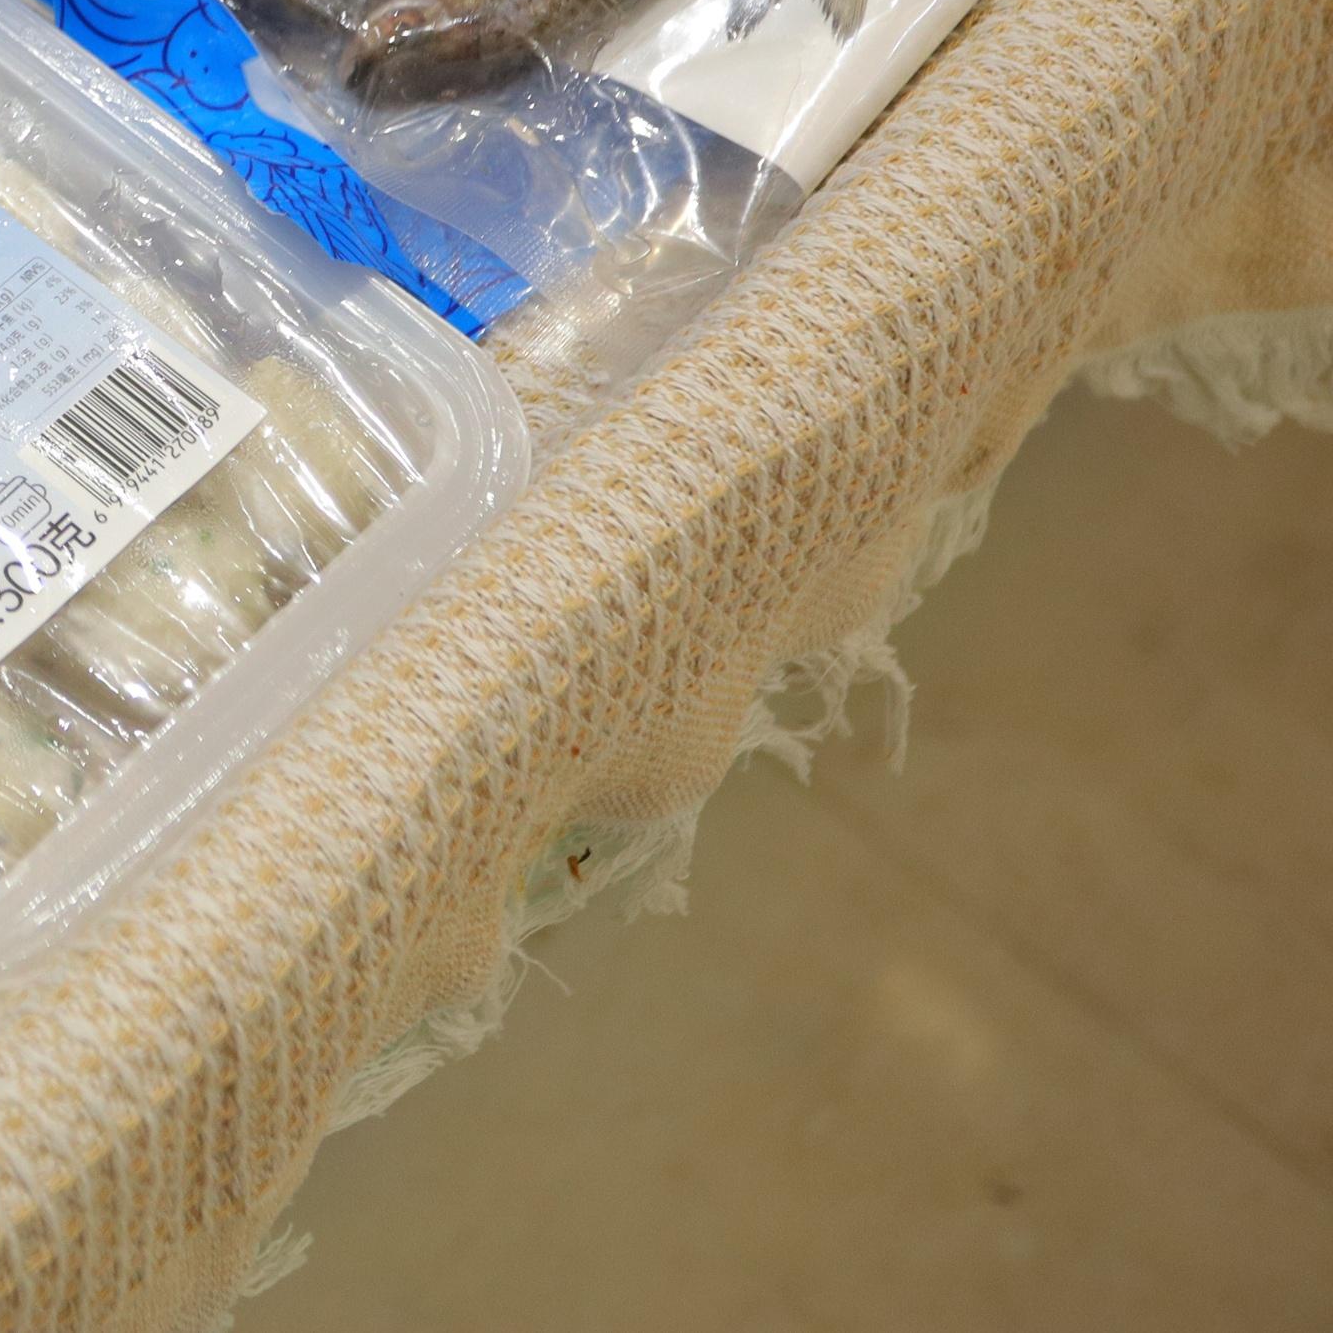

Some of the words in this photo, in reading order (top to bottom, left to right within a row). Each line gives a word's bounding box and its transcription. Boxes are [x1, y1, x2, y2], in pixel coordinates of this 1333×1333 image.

[42, 273, 62, 290] 4%
[52, 284, 77, 305] 23%
[73, 297, 94, 314] 3%
[90, 310, 109, 326] 1%
[89, 507, 110, 525] 6
